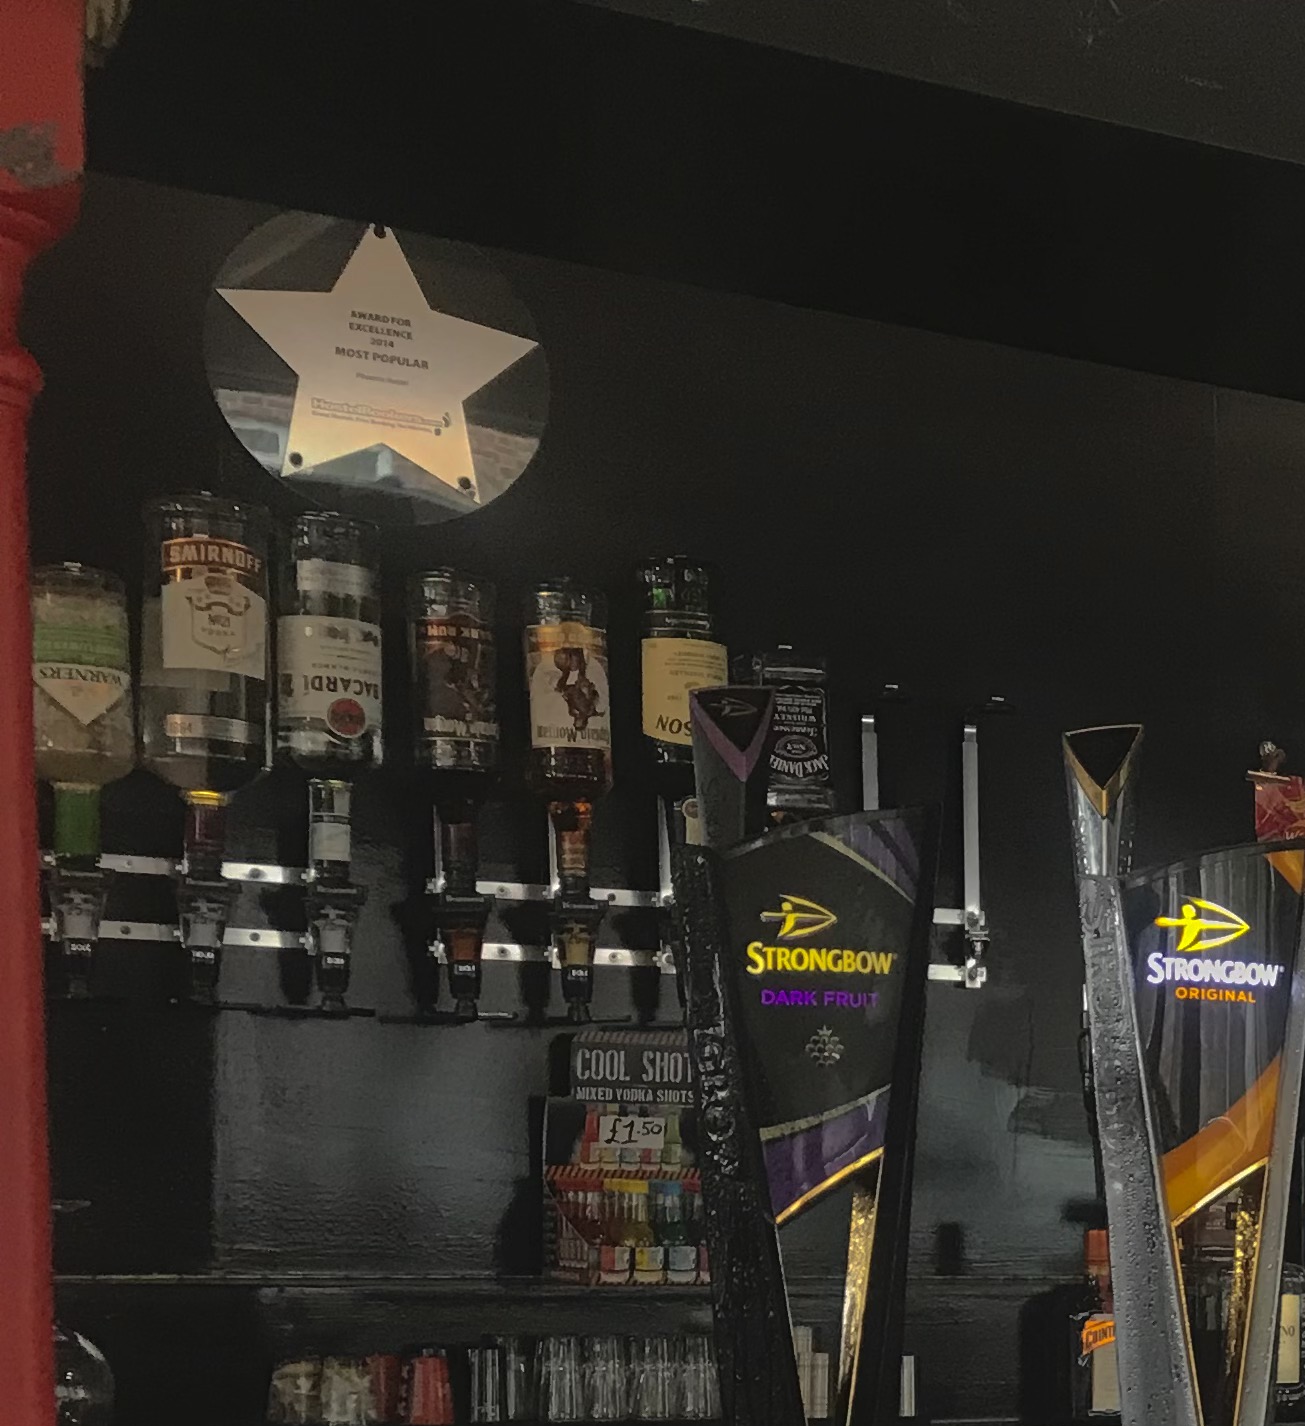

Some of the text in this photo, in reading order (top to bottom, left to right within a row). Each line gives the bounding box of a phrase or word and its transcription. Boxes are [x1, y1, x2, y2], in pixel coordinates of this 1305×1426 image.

[350, 310, 412, 327] AWARD FOR
[348, 322, 413, 340] EXCELLENCE
[335, 346, 429, 369] MOST POPULAR
[169, 544, 262, 573] SMIRNOFF
[768, 753, 830, 778] JACK DANIEL
[746, 941, 893, 975] STRONGBOW
[1147, 952, 1279, 987] STRONGBOW
[760, 988, 879, 1008] DARK FRUIT
[1175, 987, 1256, 1003] ORIGINAL
[576, 1049, 692, 1083] COOL SHOT
[576, 1087, 695, 1103] MIXED VODKA SHOTS
[604, 1118, 662, 1144] £1.50
[1086, 1326, 1115, 1349] COINT
